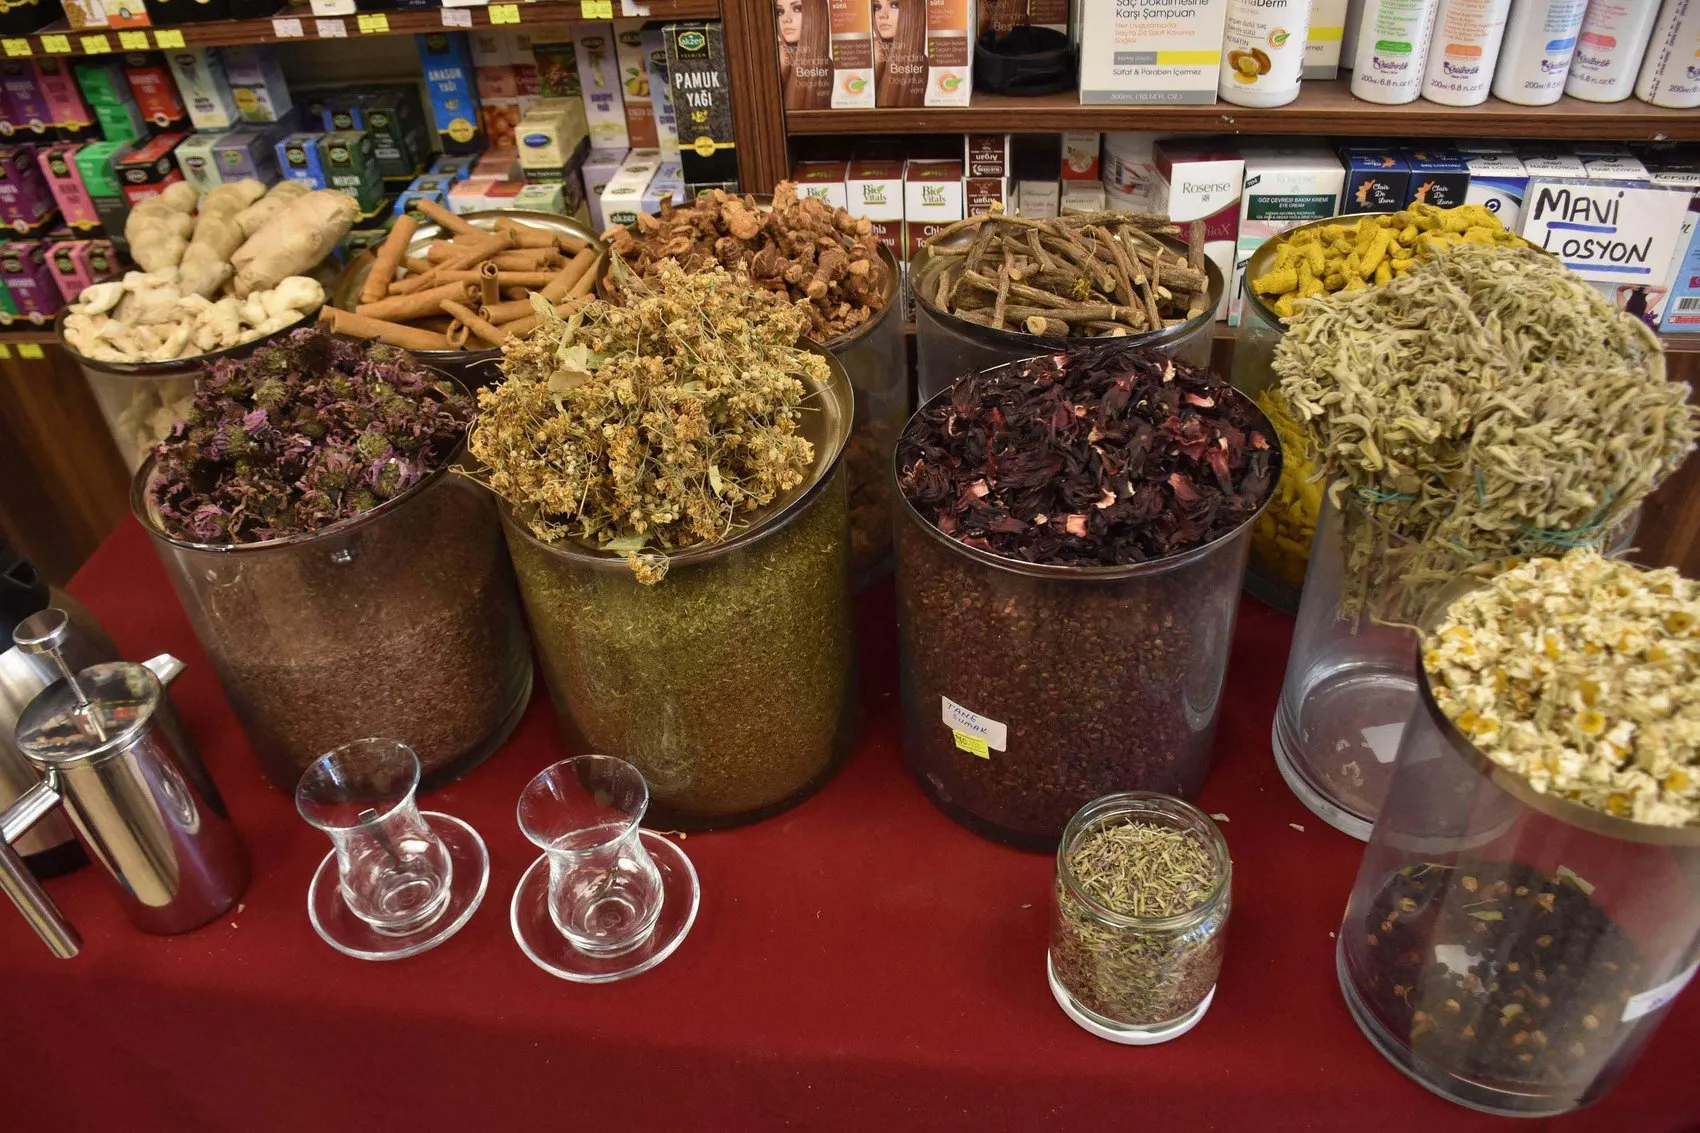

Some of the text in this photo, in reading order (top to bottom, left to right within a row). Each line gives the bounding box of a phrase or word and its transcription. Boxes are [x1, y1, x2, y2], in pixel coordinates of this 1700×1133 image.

[1116, 8, 1195, 19] Karşı Şampuan
[796, 67, 828, 77] Besler
[890, 63, 923, 74] Besler
[428, 68, 462, 81] ANASON
[675, 71, 720, 90] PAMUK
[686, 91, 713, 107] YAĞI
[807, 187, 822, 197] Bio
[863, 184, 878, 194] Bio
[923, 186, 938, 195] Bio
[1182, 182, 1231, 194] Rosense
[1271, 196, 1294, 204] ÇEVRESİ
[1543, 229, 1653, 265] LOSYON
[946, 701, 980, 723] TANE
[952, 713, 988, 735] SUMAK
